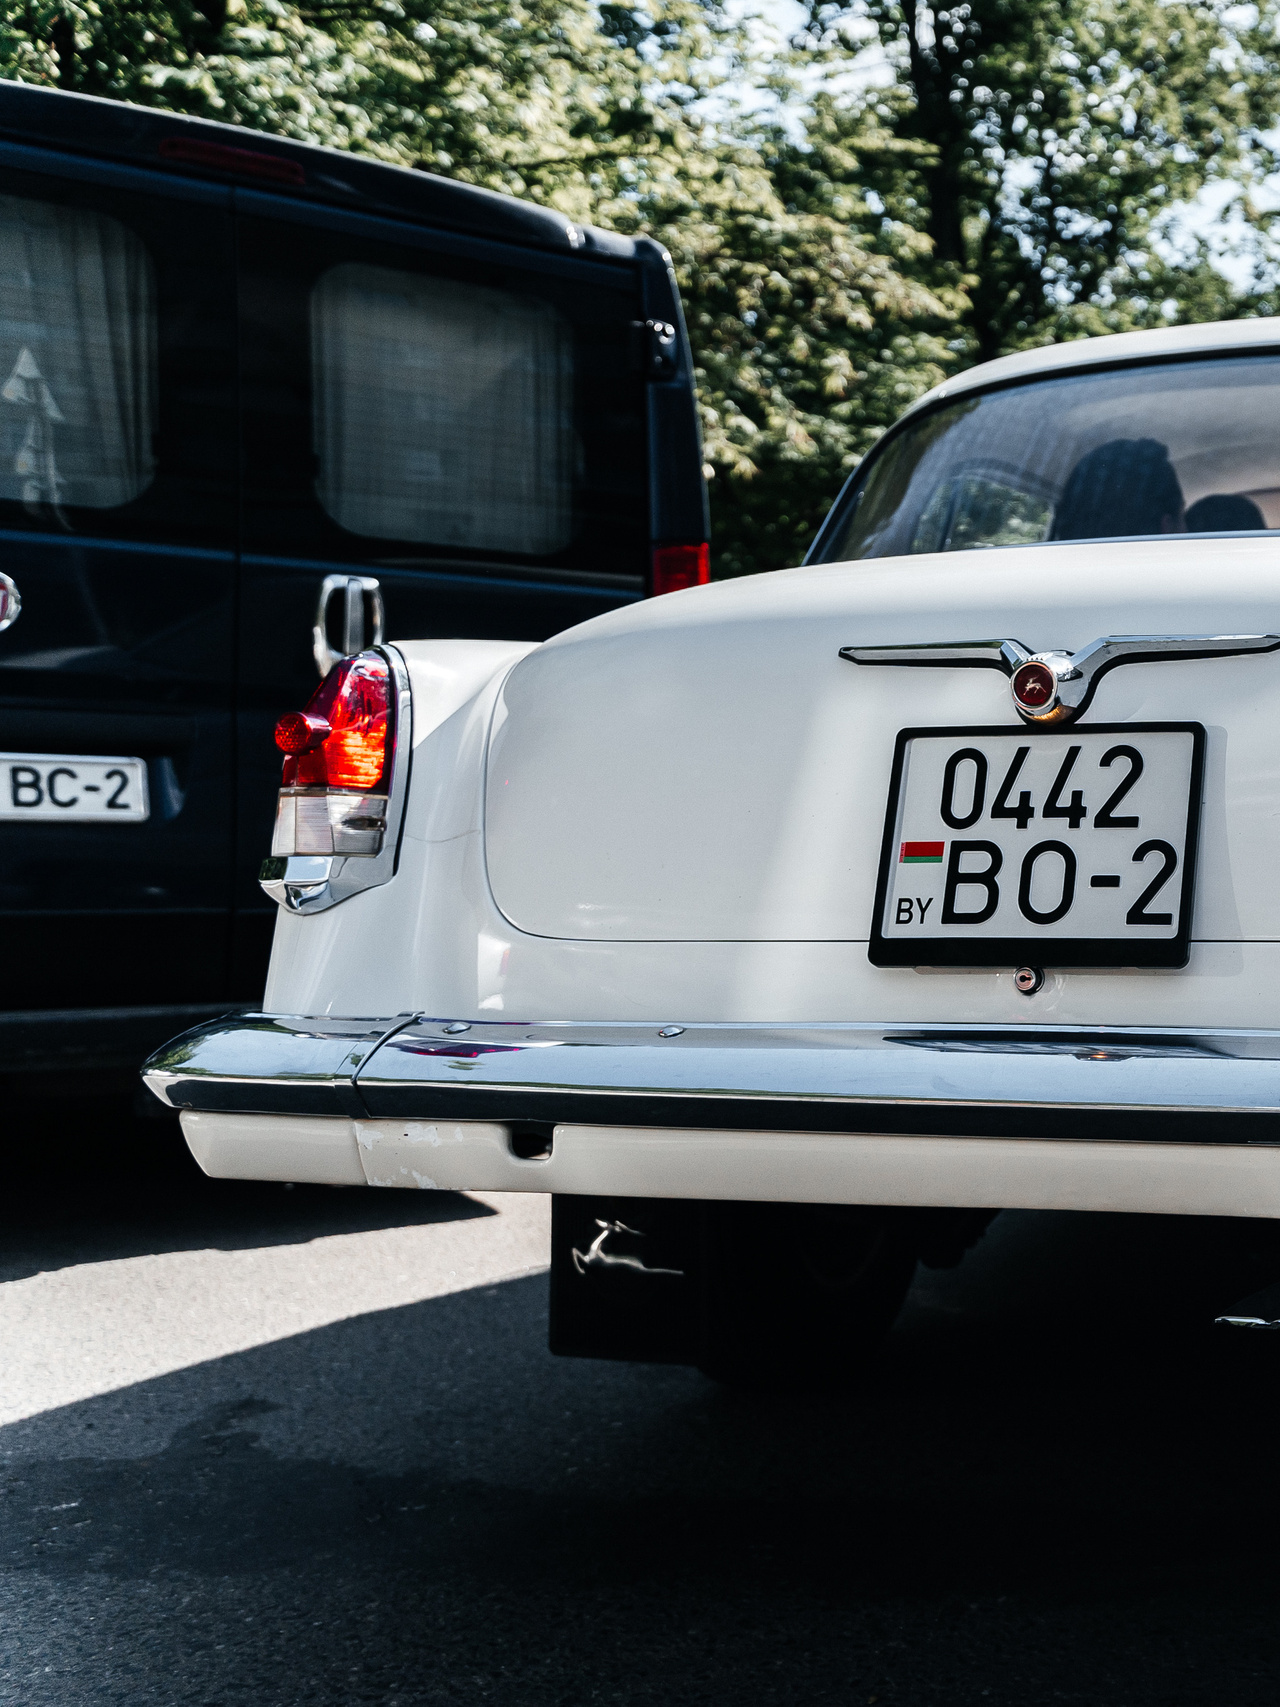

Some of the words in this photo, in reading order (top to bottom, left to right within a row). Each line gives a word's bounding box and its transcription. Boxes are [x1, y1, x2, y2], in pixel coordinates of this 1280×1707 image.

[11, 766, 130, 809] BC-2
[940, 744, 1144, 830] 0442
[895, 897, 934, 925] BY
[941, 838, 1178, 926] BO-2
